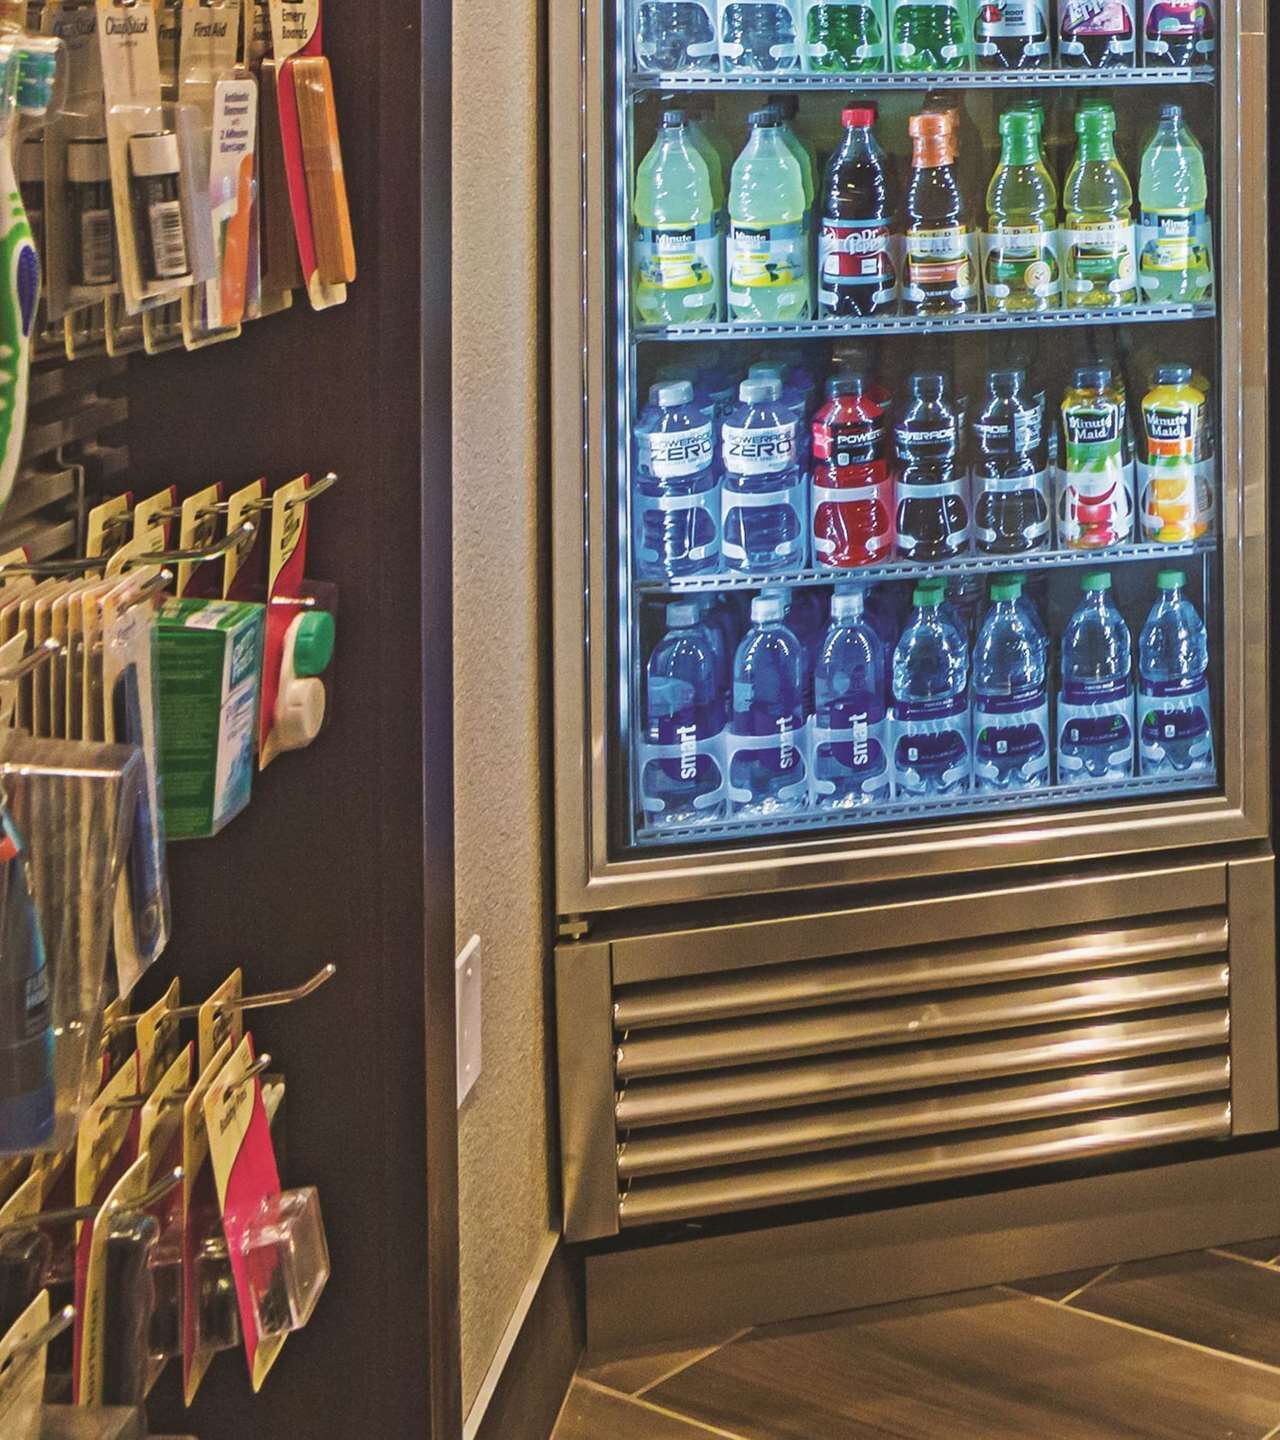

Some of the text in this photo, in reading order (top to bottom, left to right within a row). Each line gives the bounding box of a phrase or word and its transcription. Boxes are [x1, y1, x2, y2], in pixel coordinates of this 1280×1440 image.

[282, 9, 306, 23] Emery
[194, 22, 228, 37] First Aid
[282, 26, 308, 39] Boards
[655, 234, 692, 242] Minute
[1068, 414, 1112, 429] Minute
[1075, 428, 1107, 440] Maid
[1151, 425, 1185, 436] Maid
[651, 440, 712, 462] ZERO
[729, 442, 792, 458] ZERO
[776, 715, 793, 769] smart
[848, 711, 868, 765] smart
[676, 724, 697, 779] smart
